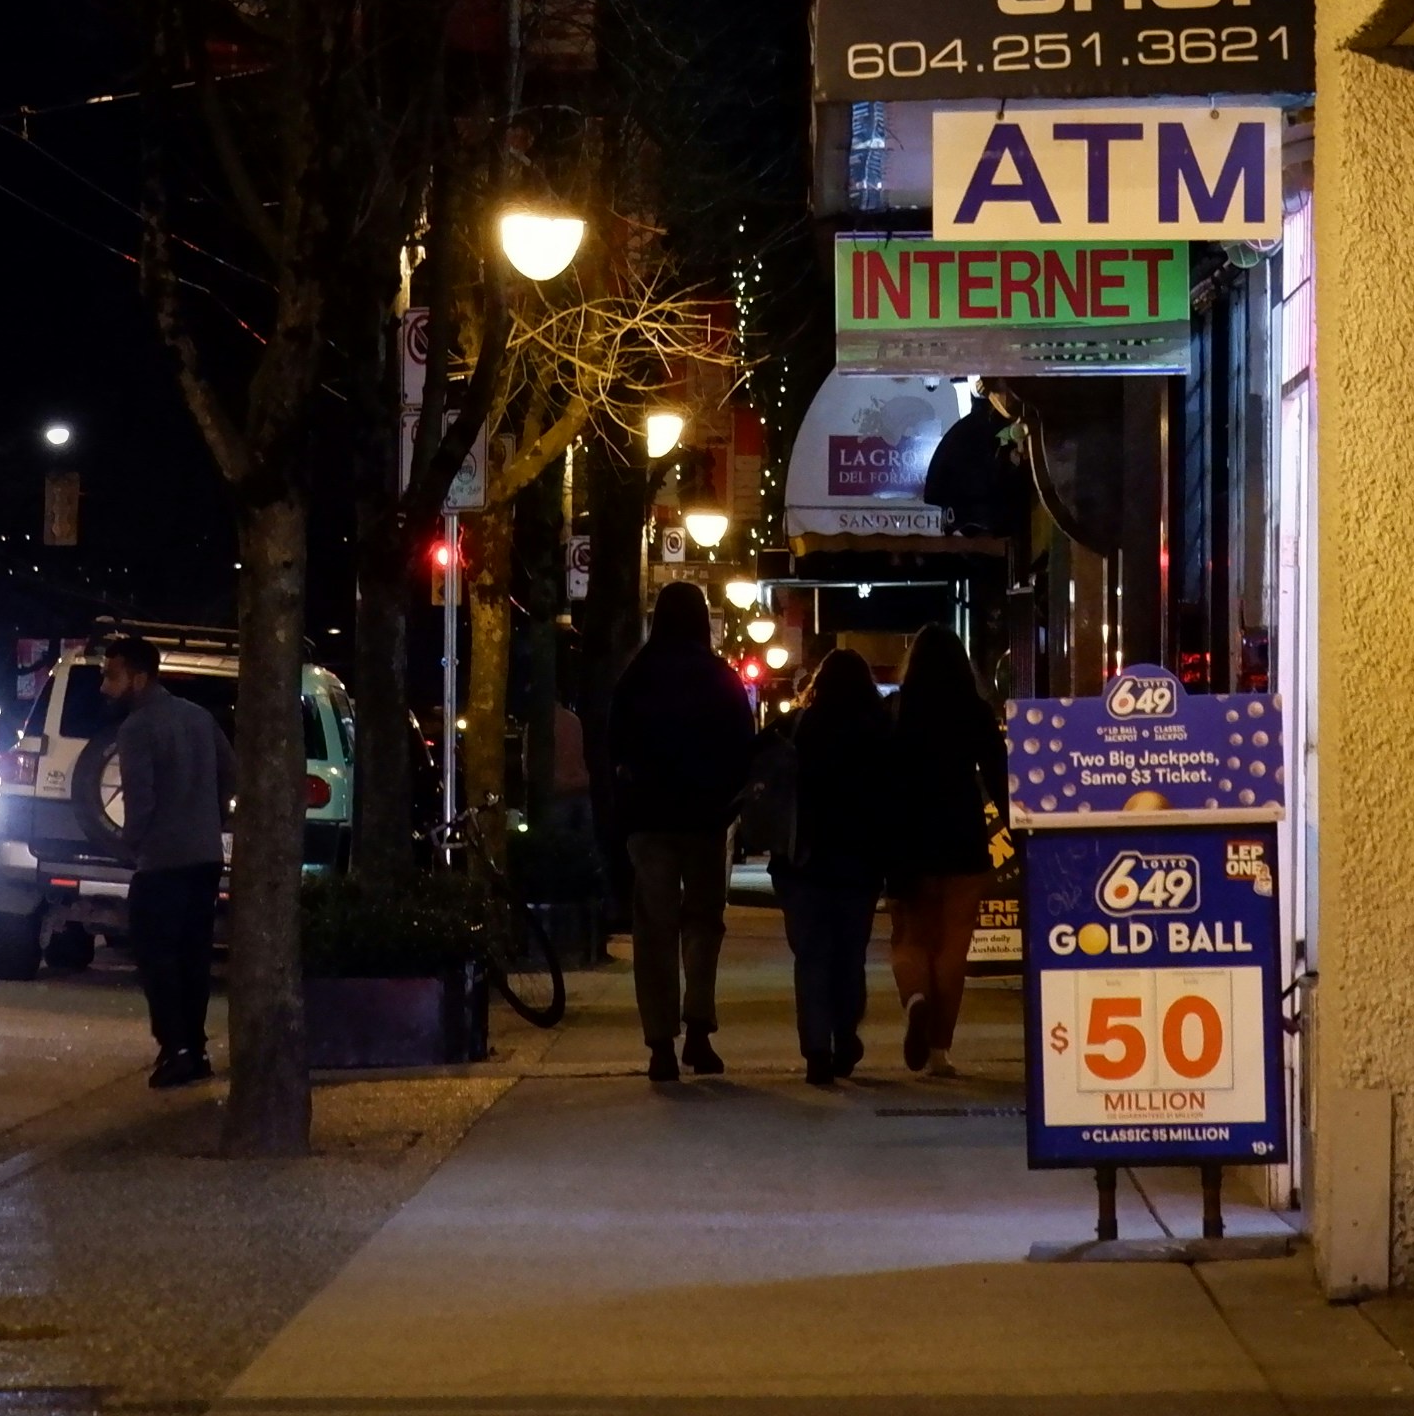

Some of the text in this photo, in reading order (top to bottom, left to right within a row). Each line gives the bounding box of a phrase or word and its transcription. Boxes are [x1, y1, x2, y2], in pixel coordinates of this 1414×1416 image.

[846, 24, 1293, 81] 604.251.3621
[953, 121, 1267, 225] ATM
[852, 248, 1174, 320] INTERNET
[869, 448, 917, 467] GRO
[839, 471, 866, 484] DEL
[1111, 680, 1172, 716] 649
[1104, 733, 1188, 743] JACKPOT JACKPOT
[1069, 749, 1220, 769] Two Big Jackpots,
[1080, 768, 1212, 787] Same $3 Ticket.
[1226, 844, 1265, 860] LEP
[1142, 859, 1188, 870] LOTTO
[1225, 860, 1263, 876] ONE
[1103, 858, 1193, 910] 649
[979, 899, 1020, 913] 'RE
[977, 914, 1018, 927] EN!
[1048, 920, 1253, 956] GOLD BALL
[1050, 994, 1223, 1080] $ 50
[1104, 1091, 1206, 1111] MILLION
[1092, 1126, 1230, 1143] CLASSIC $5 MILLION
[1251, 1140, 1275, 1156] 19+
